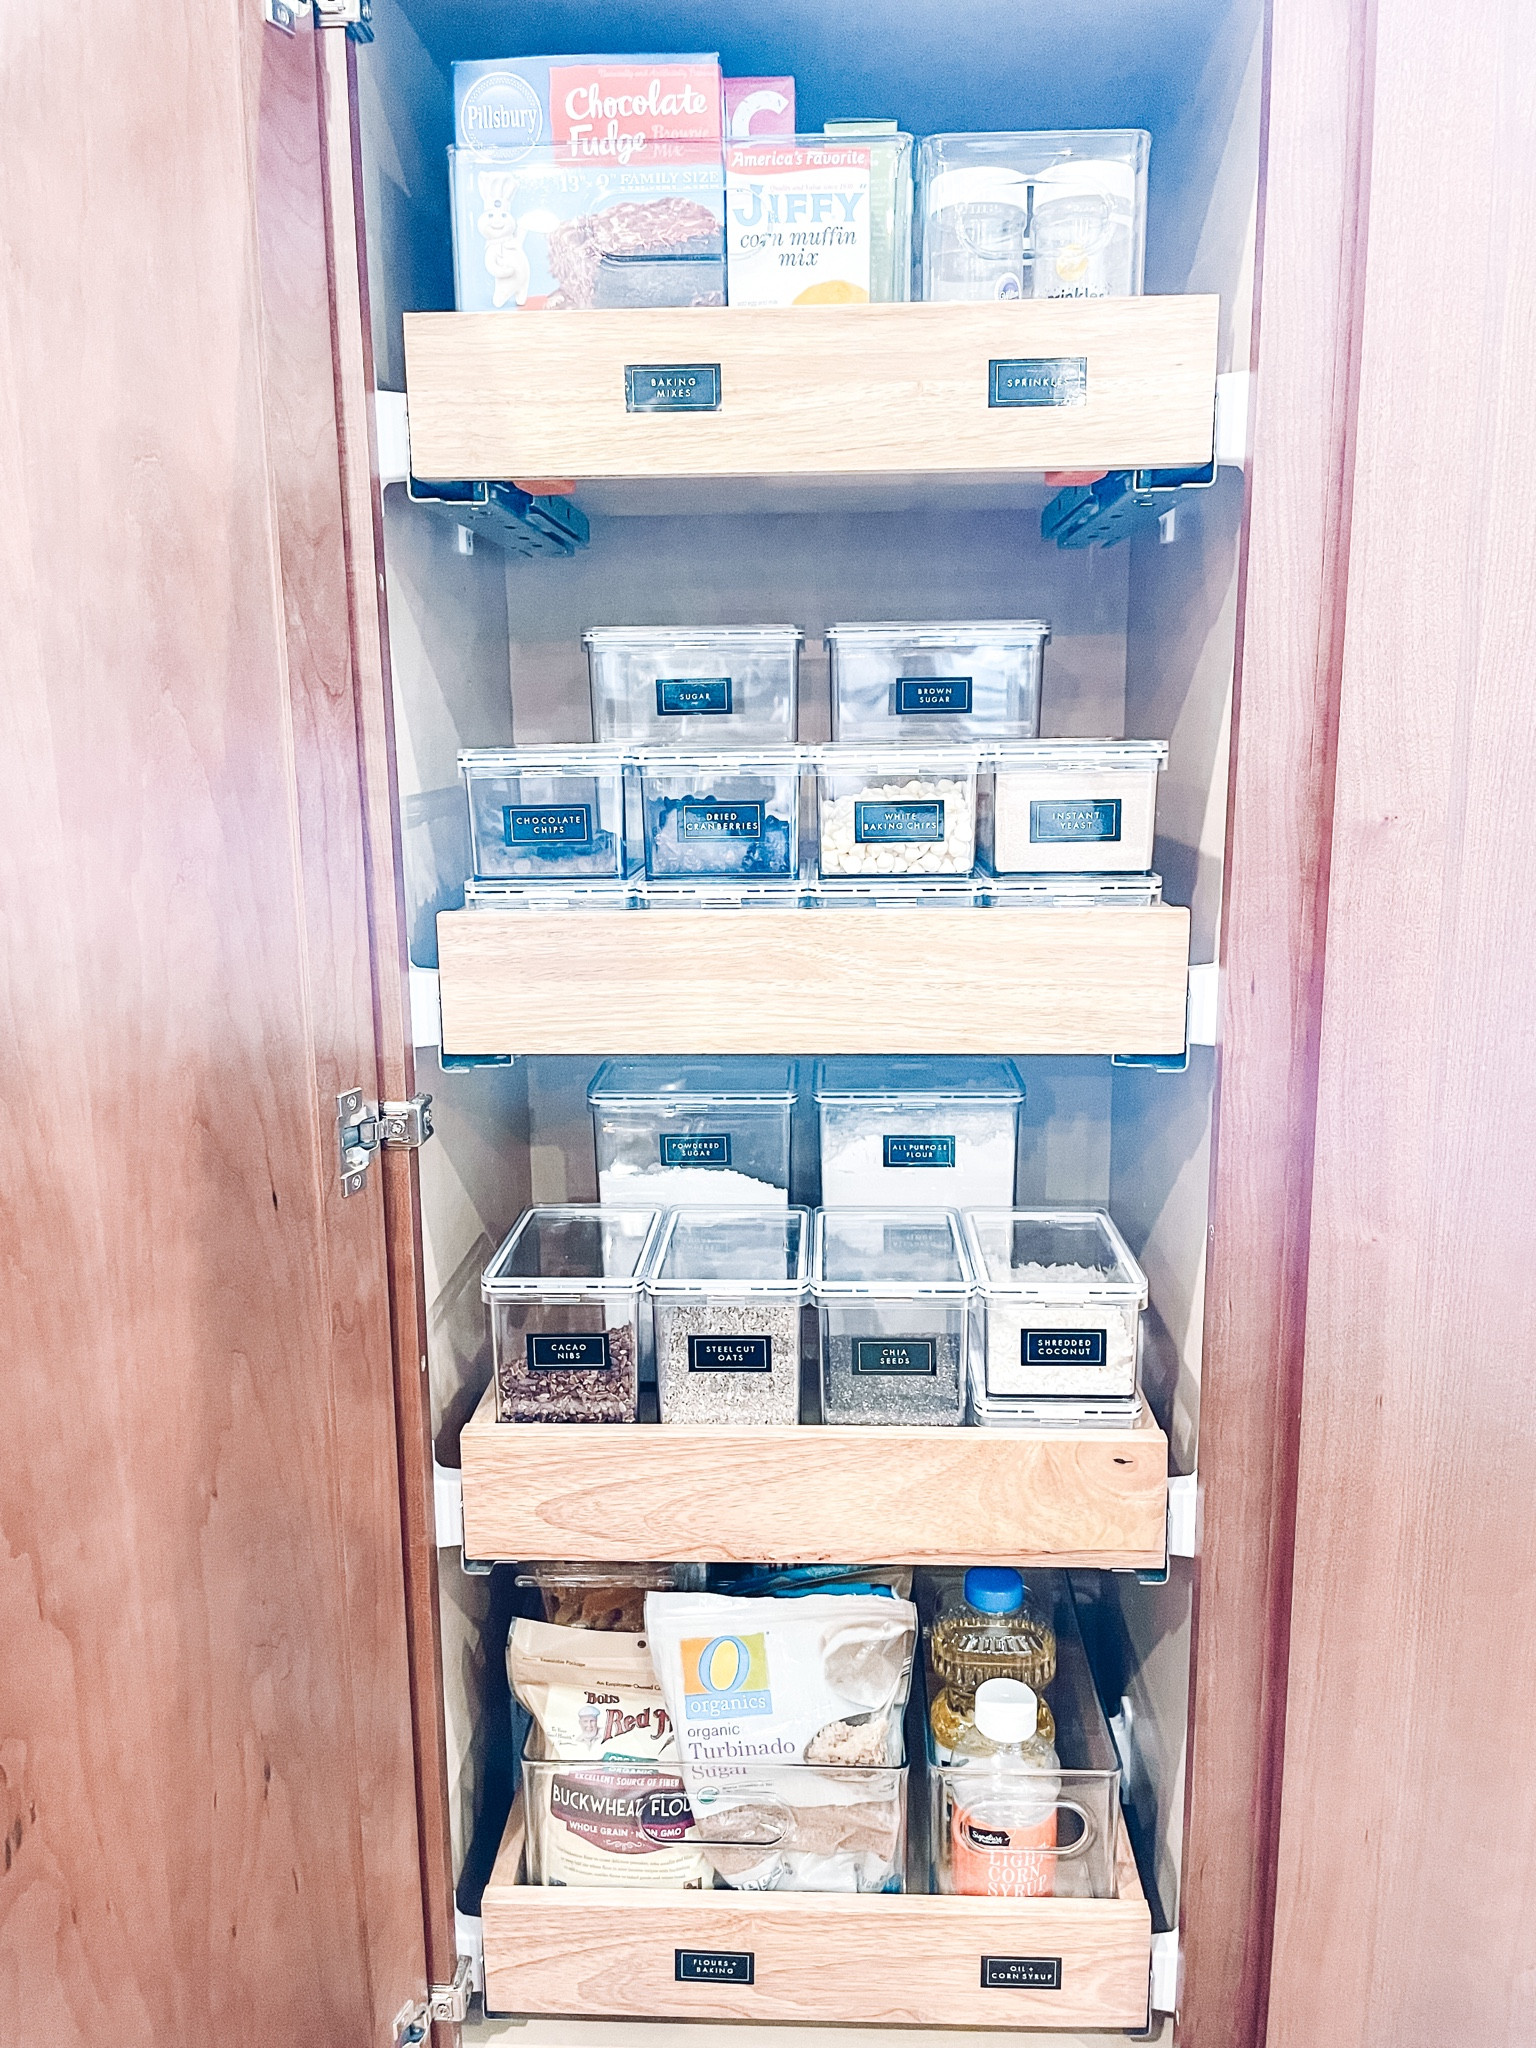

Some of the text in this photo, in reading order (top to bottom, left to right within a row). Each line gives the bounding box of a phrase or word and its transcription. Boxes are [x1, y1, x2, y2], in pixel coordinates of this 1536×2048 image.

[565, 79, 708, 120] Chocolate
[468, 104, 537, 133] Pillsbury
[567, 120, 648, 164] Fudge
[731, 151, 865, 167] America's Favorite
[621, 172, 680, 185] FAMILY
[683, 171, 719, 183] SIZE
[740, 227, 857, 249] corn muffin
[778, 248, 819, 267] mix
[651, 377, 696, 387] BAKING
[1007, 378, 1068, 388] SPRINKLES
[656, 389, 692, 398] MIXES
[680, 693, 711, 701] SUGAR
[516, 816, 581, 825] CHOCOLATE
[706, 813, 737, 821] DRIED
[884, 812, 917, 820] WHITE
[1052, 812, 1099, 820] INSTANT
[533, 826, 565, 834] CHIPS
[686, 822, 758, 831] CRANBERRIES
[864, 822, 937, 831] BAKING CHIPS
[698, 1635, 750, 1693] O
[690, 1695, 766, 1717] organics
[601, 1707, 651, 1744] Red
[687, 1723, 740, 1740] organic
[688, 1738, 796, 1760] Turbinado
[575, 1773, 680, 1787] EXCELLENT SOURCE OF FIBER
[553, 1784, 644, 1818] BUCKWHEAT
[568, 1821, 598, 1833] WHOLE
[600, 1828, 628, 1837] GRAIN
[661, 1828, 682, 1838] GMO
[988, 1863, 1040, 1884] CORN
[987, 1874, 1047, 1896] SYRUP
[694, 1959, 728, 1967] FLOURS
[696, 1967, 734, 1975] BAKING
